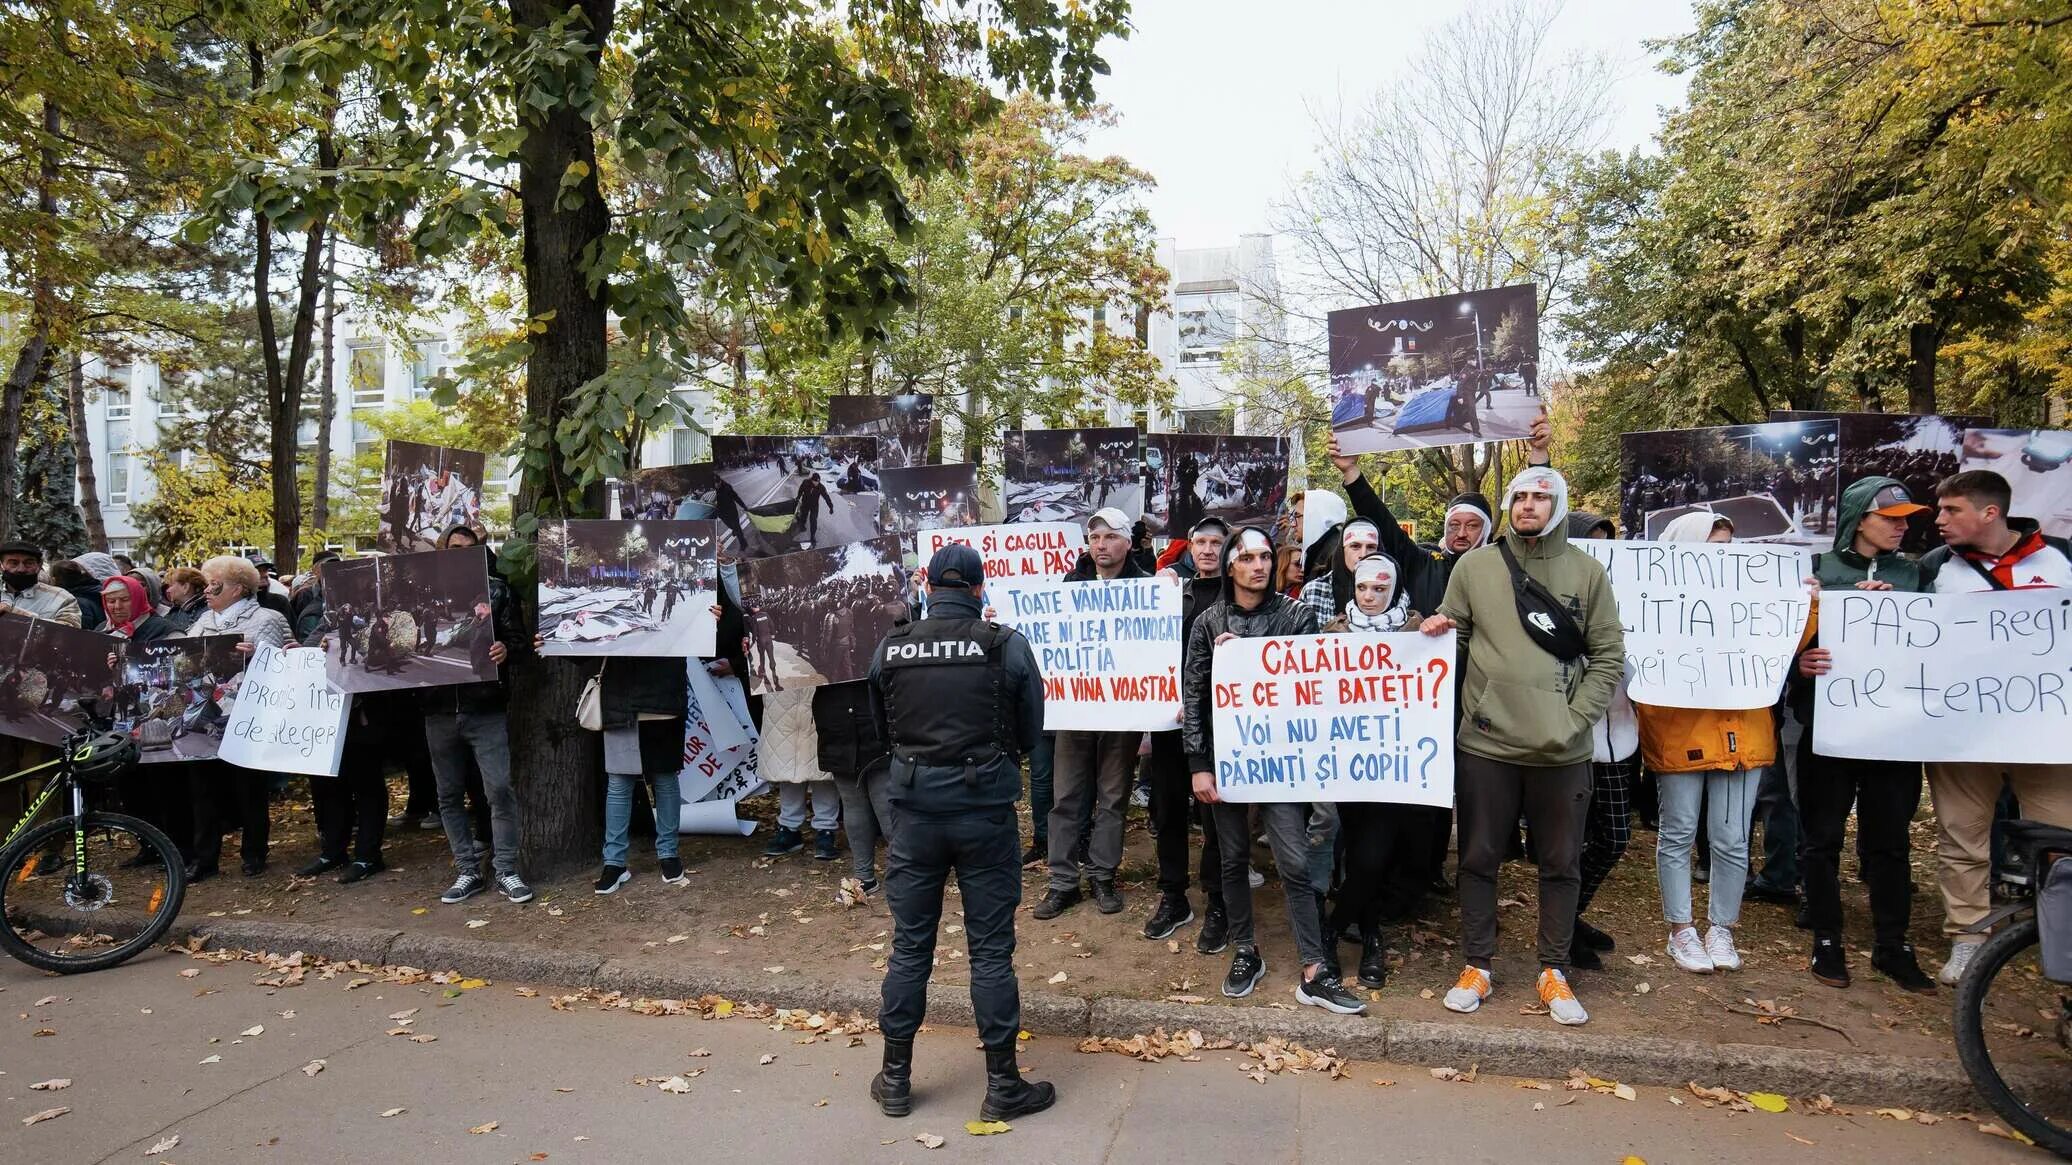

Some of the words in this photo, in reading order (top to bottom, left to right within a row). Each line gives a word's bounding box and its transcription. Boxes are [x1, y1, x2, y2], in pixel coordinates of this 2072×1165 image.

[1005, 531, 1067, 551] CAGULA
[1021, 557, 1039, 575] AL
[1008, 589, 1062, 617] TOATE
[1071, 580, 1160, 613] VÂNĂTĂILE
[1015, 621, 1050, 645] CARE
[1080, 619, 1108, 642] LE-A
[1115, 615, 1182, 642] PROVOCAT
[1730, 599, 1808, 638] PESTE
[1842, 597, 1941, 648] PAS
[1261, 638, 1401, 675] CĂLĂILOR,
[1070, 671, 1106, 702] VINA
[1110, 665, 1180, 702] VOASTRĂ
[1215, 682, 1243, 708] DE
[1253, 681, 1279, 707] CE
[1295, 680, 1323, 706] NE
[235, 716, 263, 742] de
[1287, 718, 1317, 743] NU
